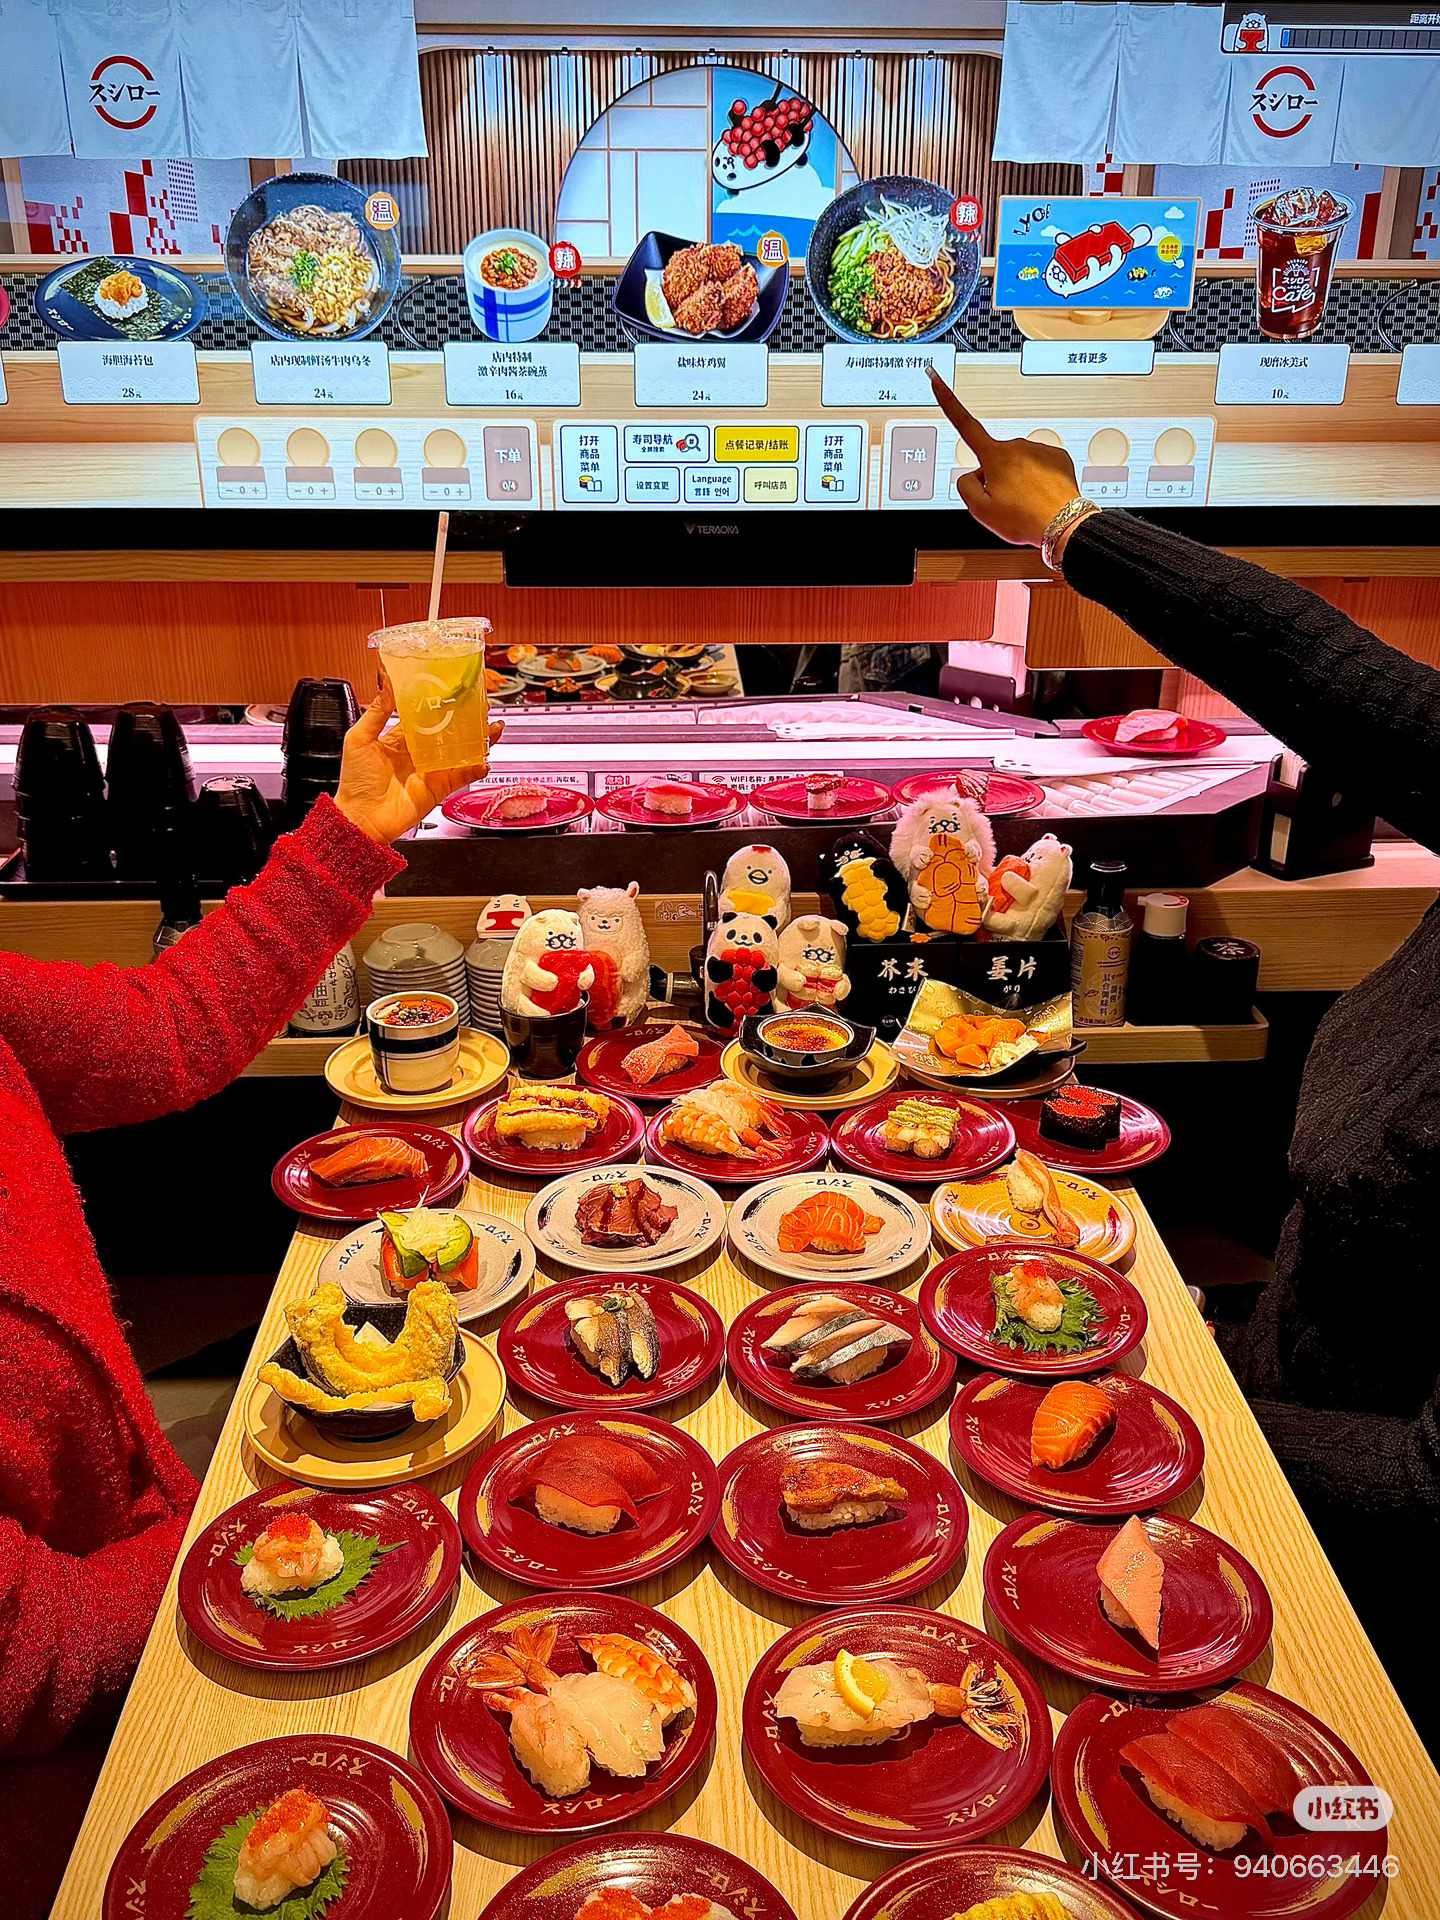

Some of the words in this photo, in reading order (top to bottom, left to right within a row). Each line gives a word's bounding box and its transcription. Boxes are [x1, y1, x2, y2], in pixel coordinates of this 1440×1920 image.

[88, 82, 161, 104] スシロー
[1249, 92, 1318, 112] スシロー
[371, 199, 393, 224] 温
[957, 203, 977, 225] 辣
[555, 249, 576, 272] 辣
[762, 238, 783, 262] 温
[492, 351, 533, 363] 店内特制
[1067, 353, 1108, 364] 查看更多
[1259, 356, 1309, 368] 现磨冰美式
[478, 365, 548, 378] 激辛肉酱茶碗蒸
[579, 435, 600, 446] 打开
[632, 434, 674, 445] 寿司导航
[724, 440, 789, 451] 点餐记录/结账
[824, 435, 845, 446] 打开
[494, 448, 522, 464] 下单
[579, 448, 600, 460] 商品
[823, 448, 844, 460] 商品
[900, 448, 927, 464] 下单
[580, 462, 600, 473] 菜单
[823, 462, 843, 473] 菜单
[503, 481, 516, 491] 0/4
[636, 481, 670, 491] 设置变更
[692, 475, 732, 485] Language
[754, 481, 787, 491] 呼叫店员
[905, 480, 918, 491] 0/4
[697, 525, 739, 534] TERAOKA
[878, 957, 928, 981] 芥末
[987, 955, 1037, 980] 姜片
[888, 986, 916, 994] わさび
[1003, 985, 1021, 993] がり
[414, 1133, 449, 1149] スシロー
[802, 1131, 817, 1154] スシロー
[581, 1170, 627, 1183] スシロー
[805, 1178, 855, 1188] スシロー
[1057, 1179, 1102, 1201] スシロー
[476, 1222, 514, 1245] スシロー
[694, 1211, 710, 1238] スシロー
[546, 1238, 587, 1259] スシロー
[743, 1230, 772, 1257] スシロー
[886, 1237, 913, 1262] スシロー
[338, 1240, 365, 1271] スシロー
[857, 1294, 910, 1315] スシロー
[1109, 1306, 1131, 1340] スシロー
[865, 1390, 916, 1411] スシロー
[965, 1412, 985, 1453] スシロー
[687, 1471, 704, 1516] スシロー
[391, 1493, 438, 1530] スシロー
[935, 1493, 951, 1540] スシロー
[207, 1517, 247, 1567] スシロー
[497, 1546, 558, 1572] スシロー
[745, 1553, 807, 1586] スシロー
[1002, 1559, 1021, 1610] スシロー
[290, 1635, 365, 1655] スシロー
[292, 1752, 371, 1777] スシロー
[540, 1793, 622, 1815] スシロー
[943, 1784, 1007, 1827] スシロー
